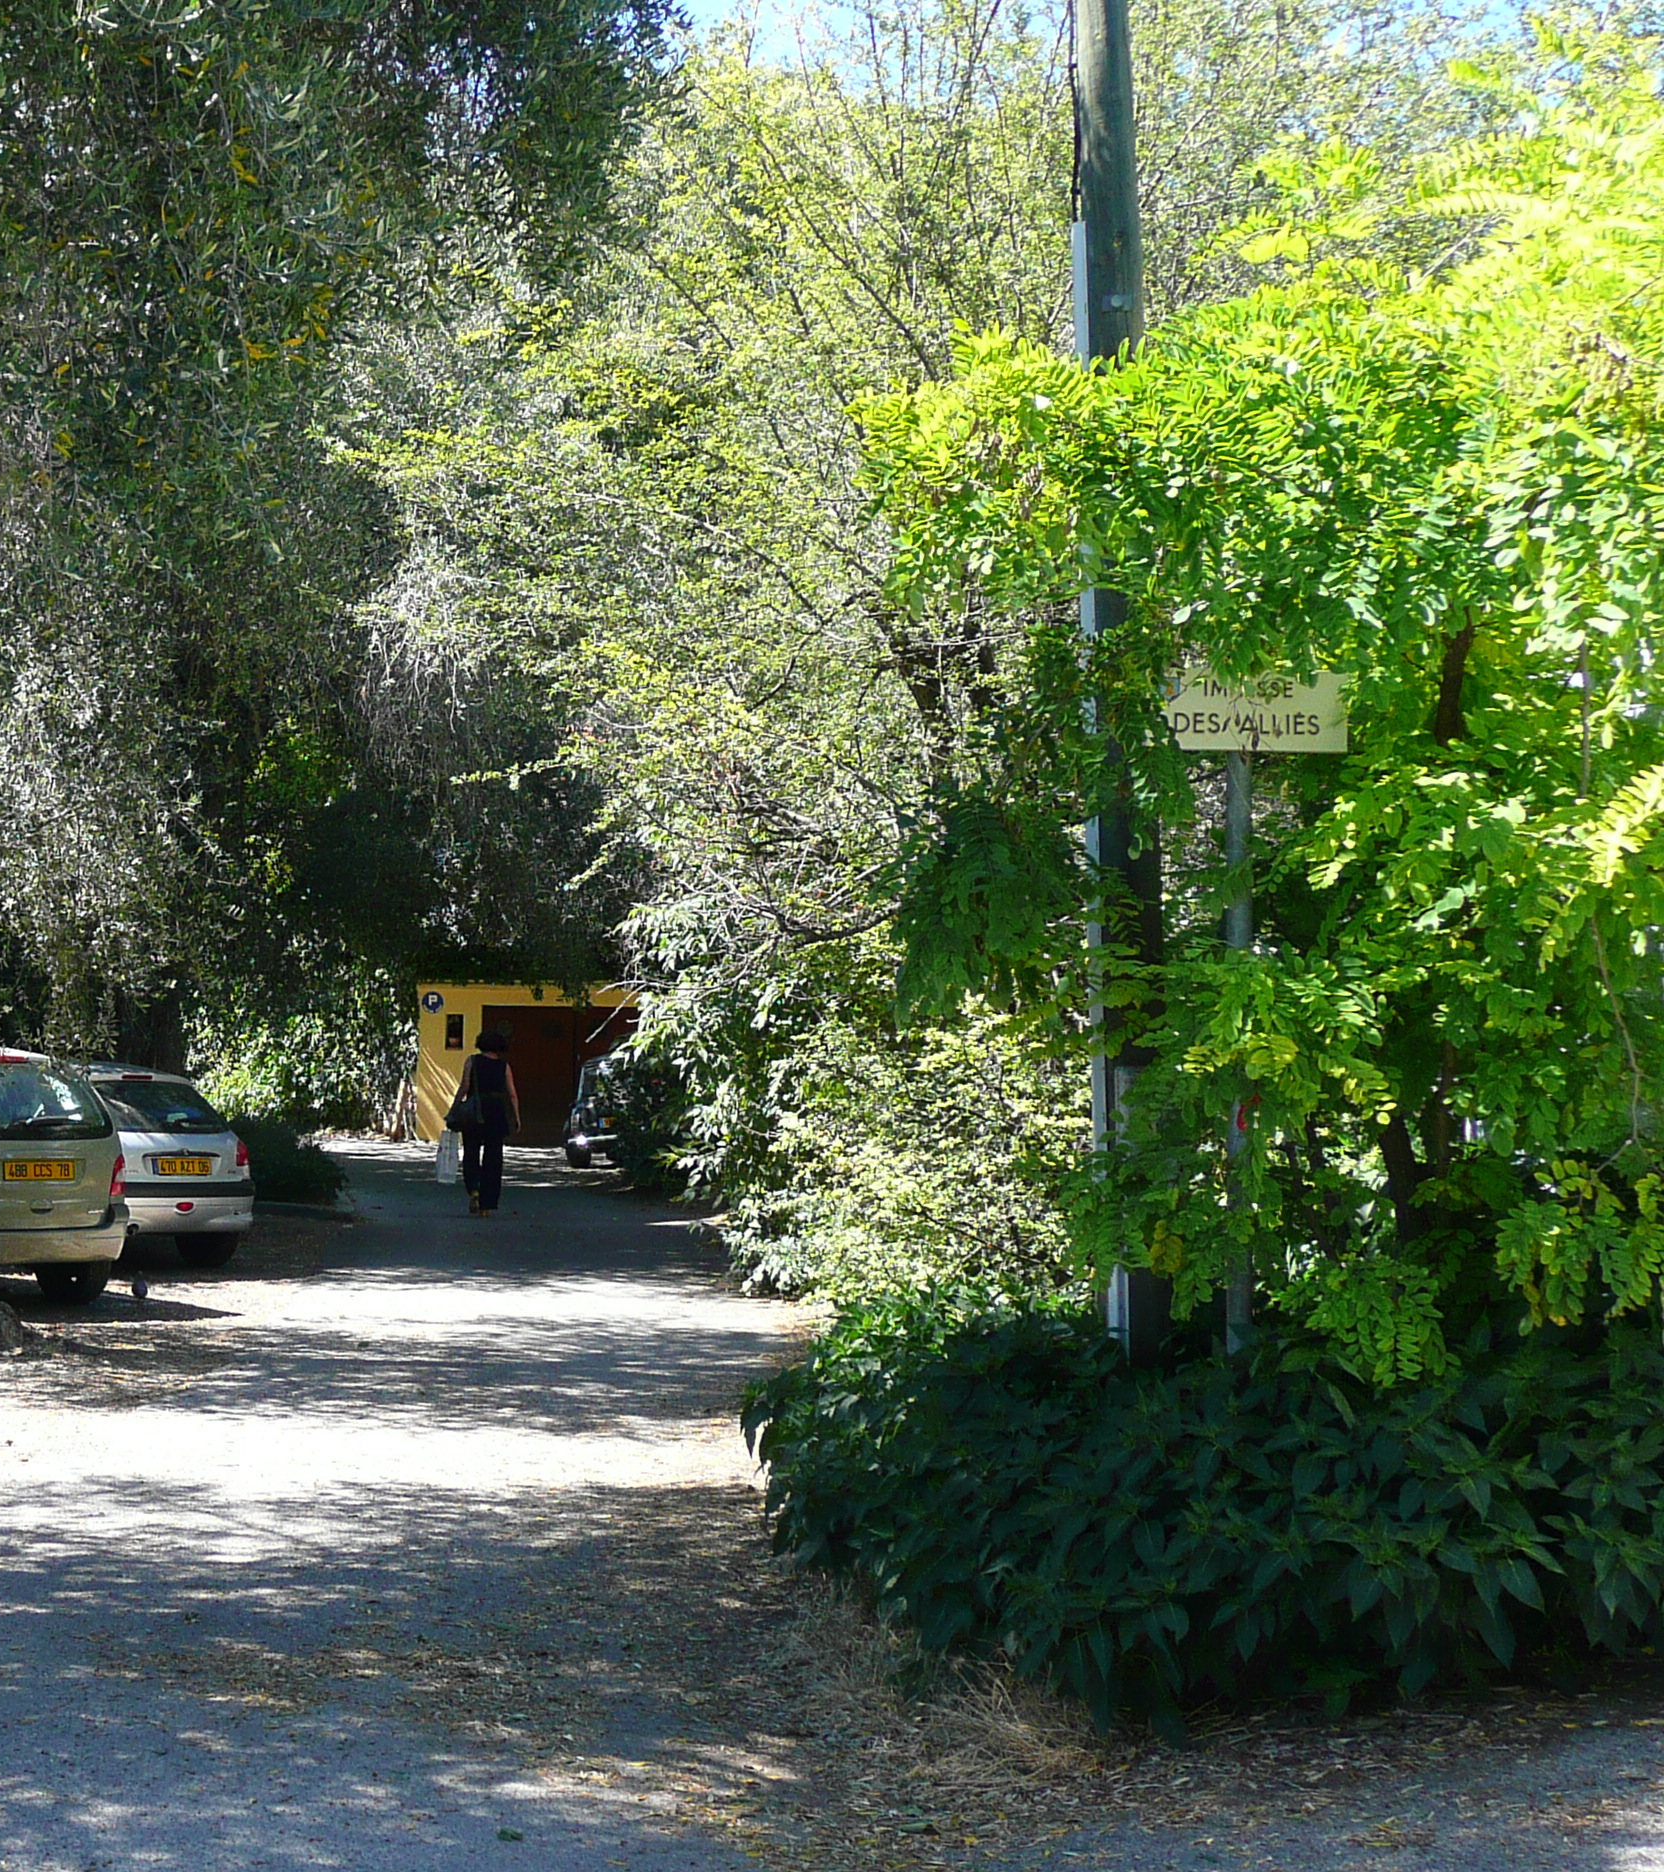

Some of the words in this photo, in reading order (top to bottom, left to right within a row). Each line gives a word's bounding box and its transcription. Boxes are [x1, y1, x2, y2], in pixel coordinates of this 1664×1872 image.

[1204, 680, 1293, 697] IMSSE
[1173, 713, 1220, 734] DES
[33, 1164, 52, 1177] CCS
[180, 1161, 196, 1173] AZT
